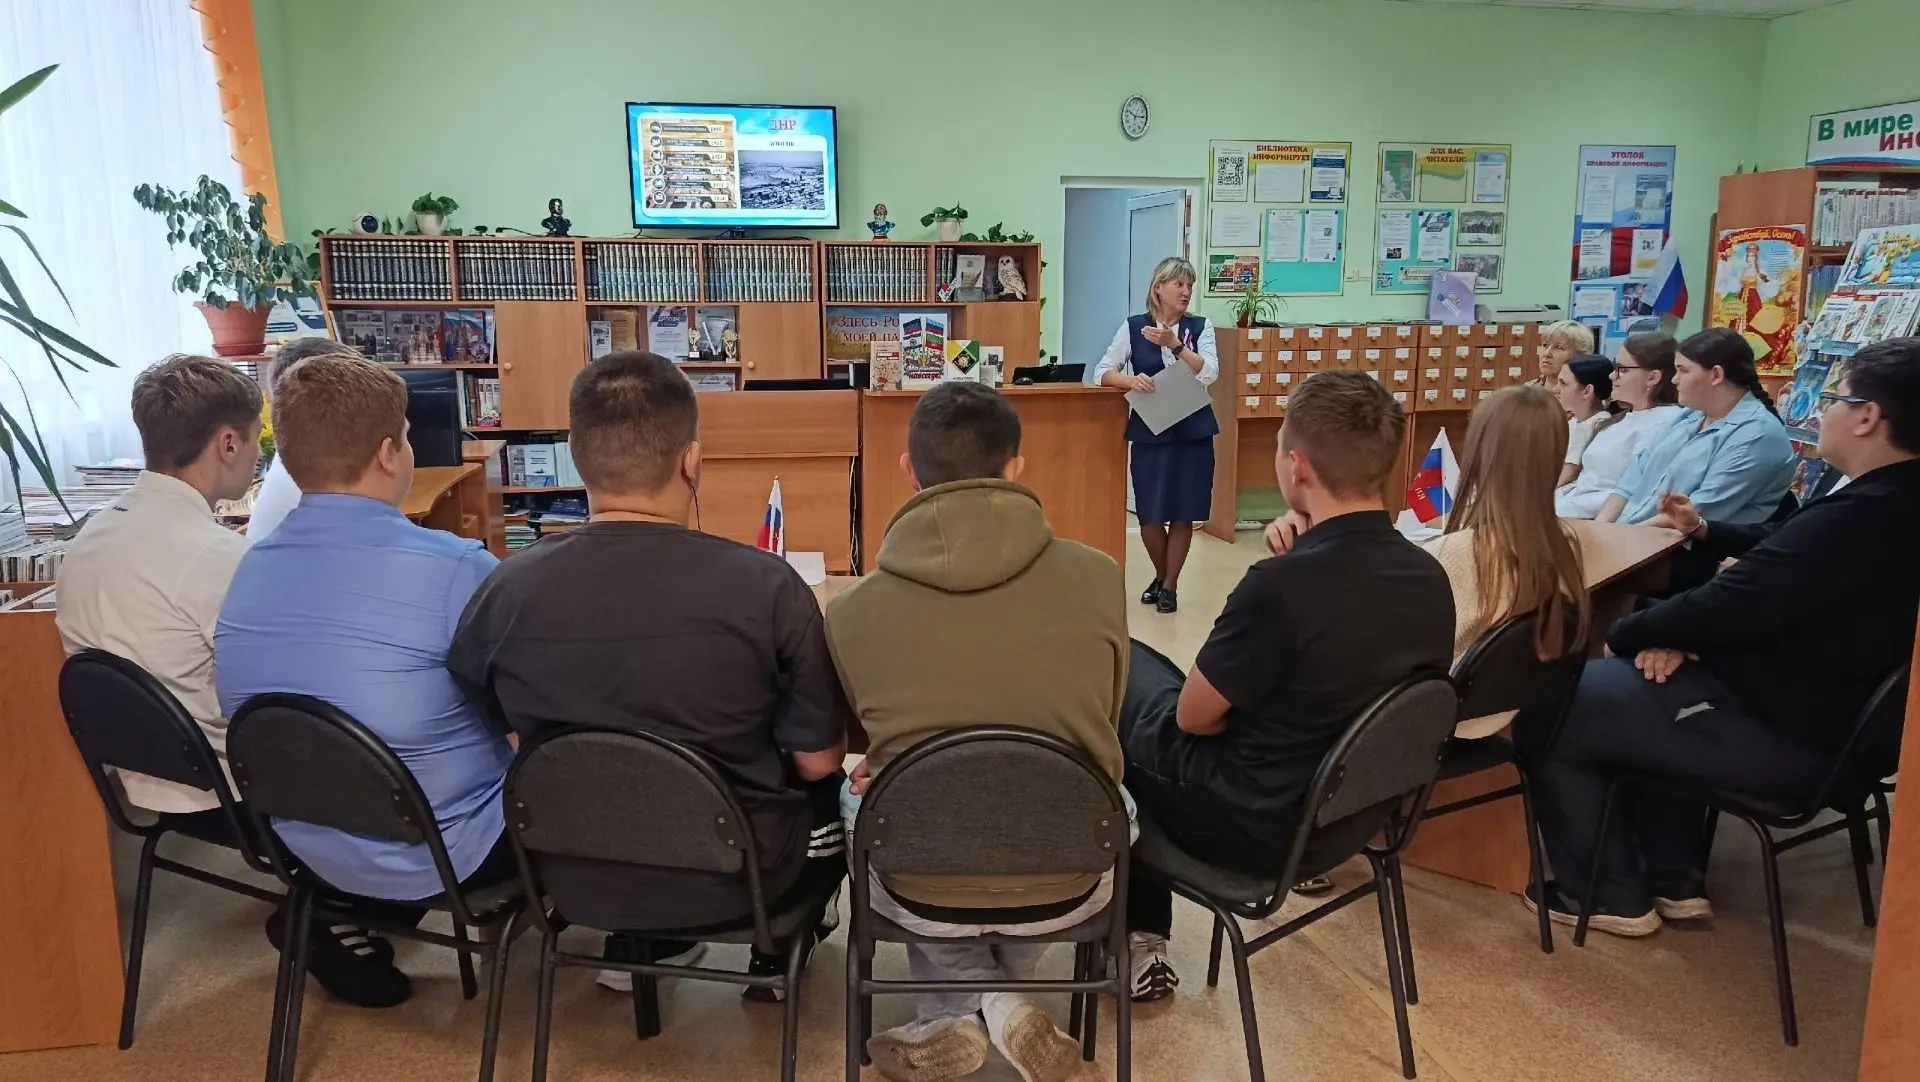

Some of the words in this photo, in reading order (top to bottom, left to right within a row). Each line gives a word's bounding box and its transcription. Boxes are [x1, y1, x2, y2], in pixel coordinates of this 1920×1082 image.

[1818, 119, 1835, 141] В
[1843, 113, 1913, 138] мире
[1772, 229, 1795, 240] Осень!
[838, 316, 878, 327] ЗДЕСЬ
[844, 331, 877, 342] МОЕЙ
